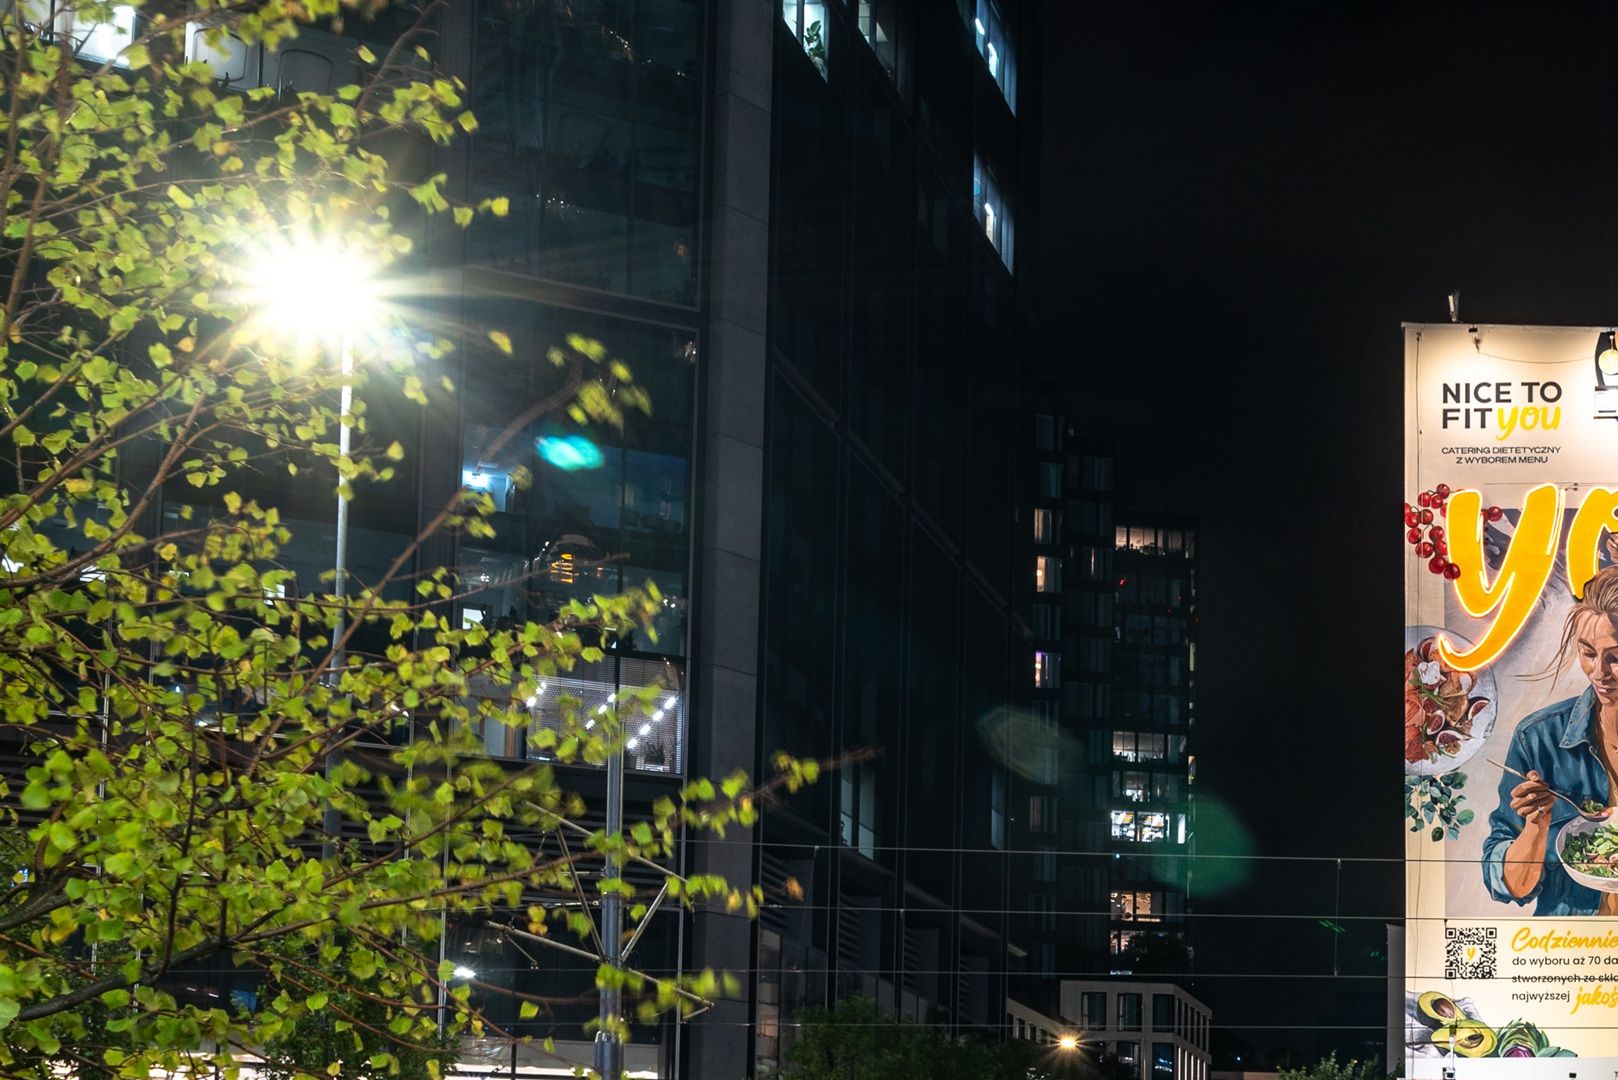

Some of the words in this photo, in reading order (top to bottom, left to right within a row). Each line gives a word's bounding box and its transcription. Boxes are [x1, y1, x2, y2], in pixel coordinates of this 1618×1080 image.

[1442, 382, 1512, 404] NICE
[1521, 381, 1562, 403] TO
[1442, 408, 1492, 429] FIT
[1495, 406, 1561, 441] you
[1441, 446, 1491, 455] CATERING
[1492, 446, 1562, 454] DIETETYCZNY
[1456, 456, 1463, 464] Z
[1464, 456, 1517, 464] WYBOREM
[1518, 456, 1548, 464] MENU
[1512, 957, 1527, 966] do
[1529, 957, 1570, 968] wyboru
[1573, 956, 1585, 965] aż
[1588, 956, 1601, 965] 70
[1512, 974, 1581, 985] stworzonych
[1512, 990, 1570, 1003] najwyższej
